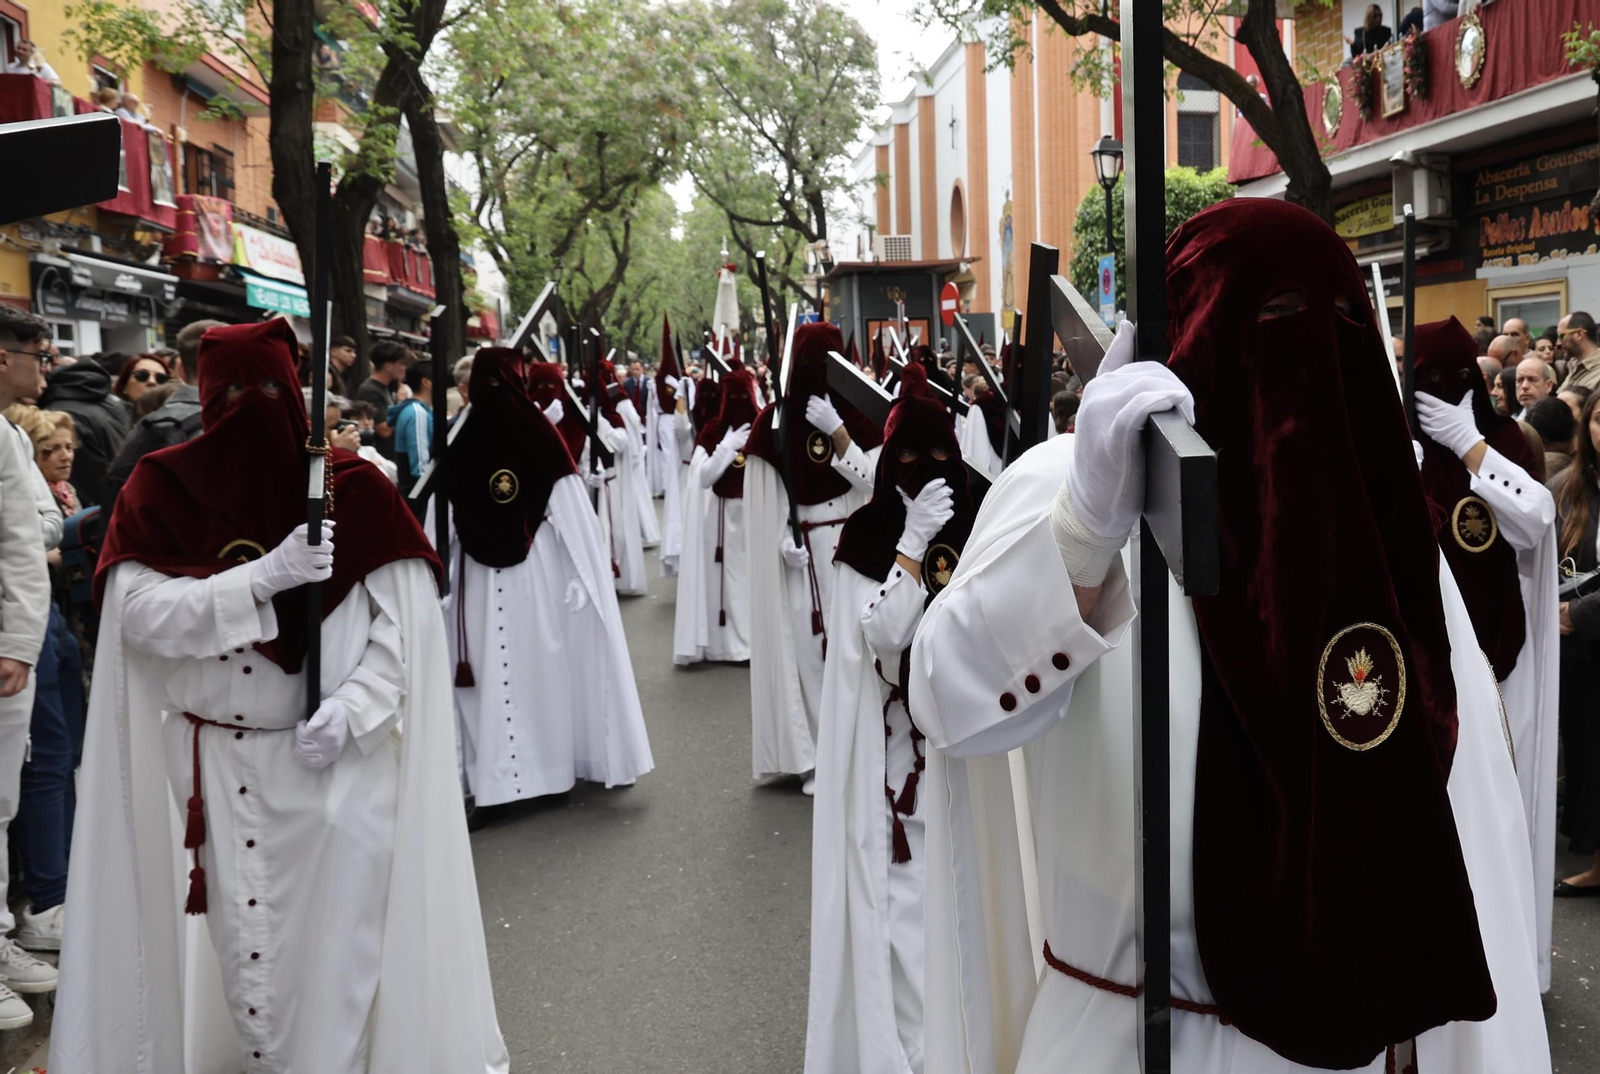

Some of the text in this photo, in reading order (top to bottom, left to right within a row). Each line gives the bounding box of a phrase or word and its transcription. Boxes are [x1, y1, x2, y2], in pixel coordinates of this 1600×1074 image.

[1371, 197, 1393, 209] Gou
[1475, 177, 1558, 205] La Despensa
[1480, 212, 1525, 247] Pollos
[1528, 200, 1590, 239] Asados
